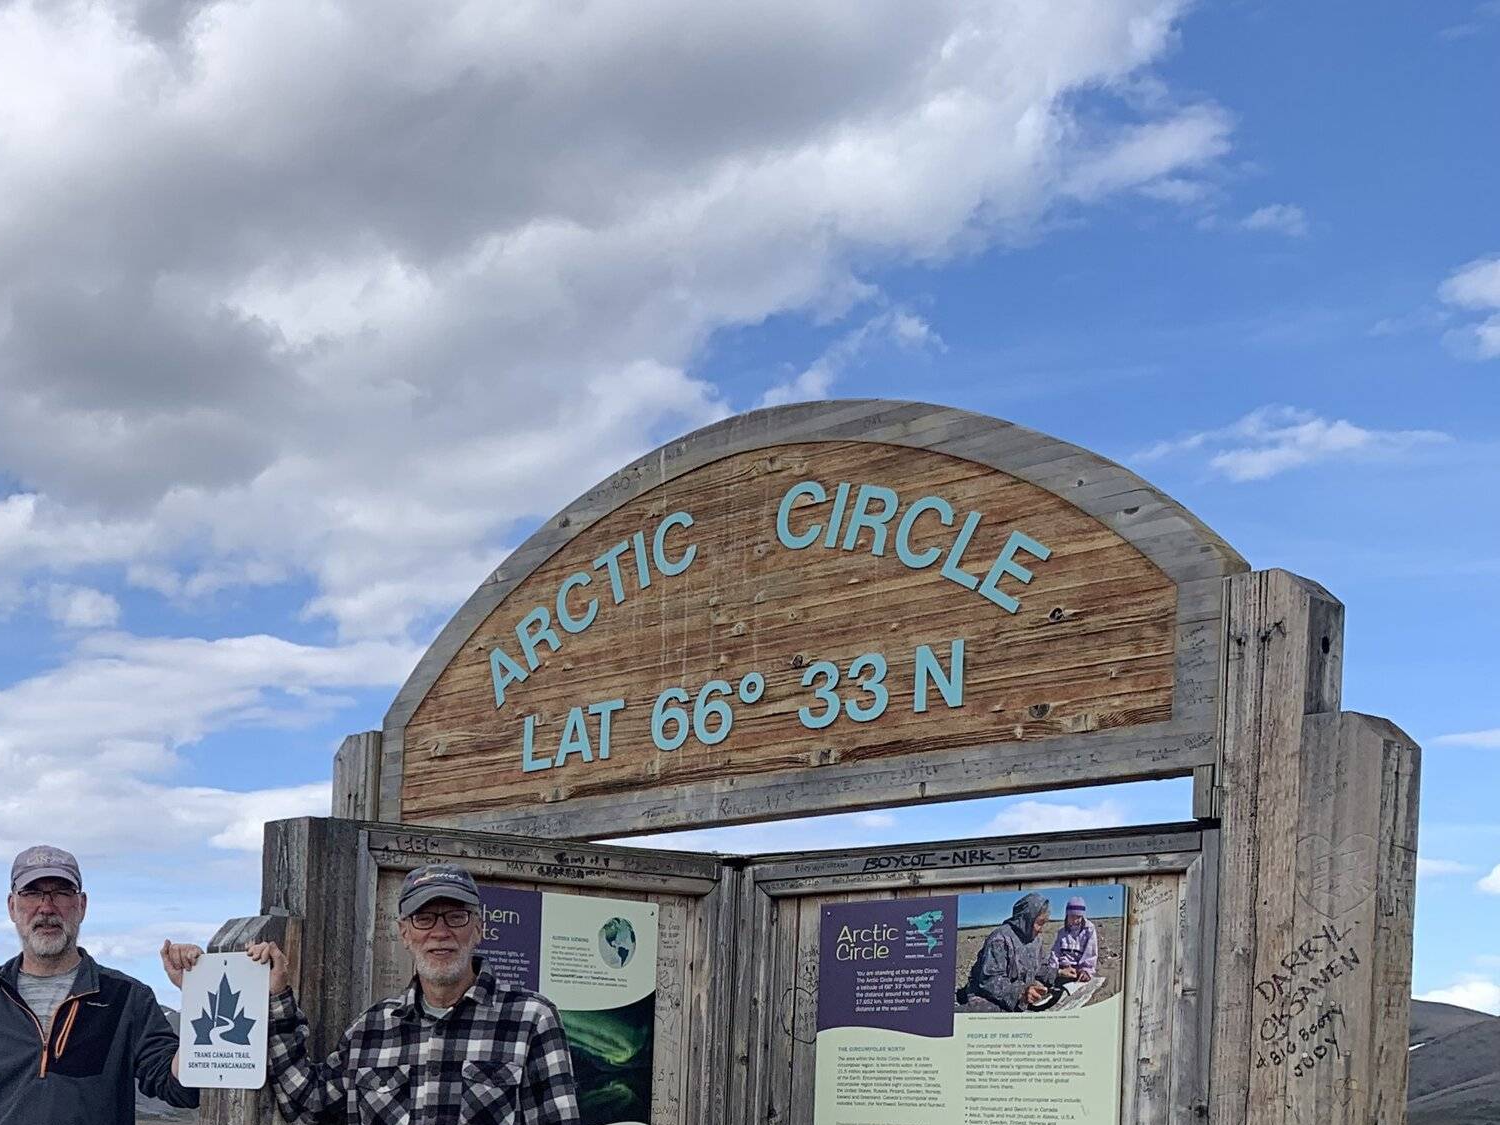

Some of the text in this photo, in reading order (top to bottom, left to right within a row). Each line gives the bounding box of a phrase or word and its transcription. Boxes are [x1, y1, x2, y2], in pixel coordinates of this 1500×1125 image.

[489, 482, 1050, 705] ARCTIC CIRCLE
[523, 640, 965, 772] LAT 66° 33 N
[836, 943, 890, 961] Circle
[837, 924, 899, 943] Arctic
[1255, 925, 1351, 1005] DARRYL
[1269, 1041, 1296, 1066] BIG
[1298, 1003, 1347, 1041] BOOTY
[1294, 1030, 1340, 1077] JUDY
